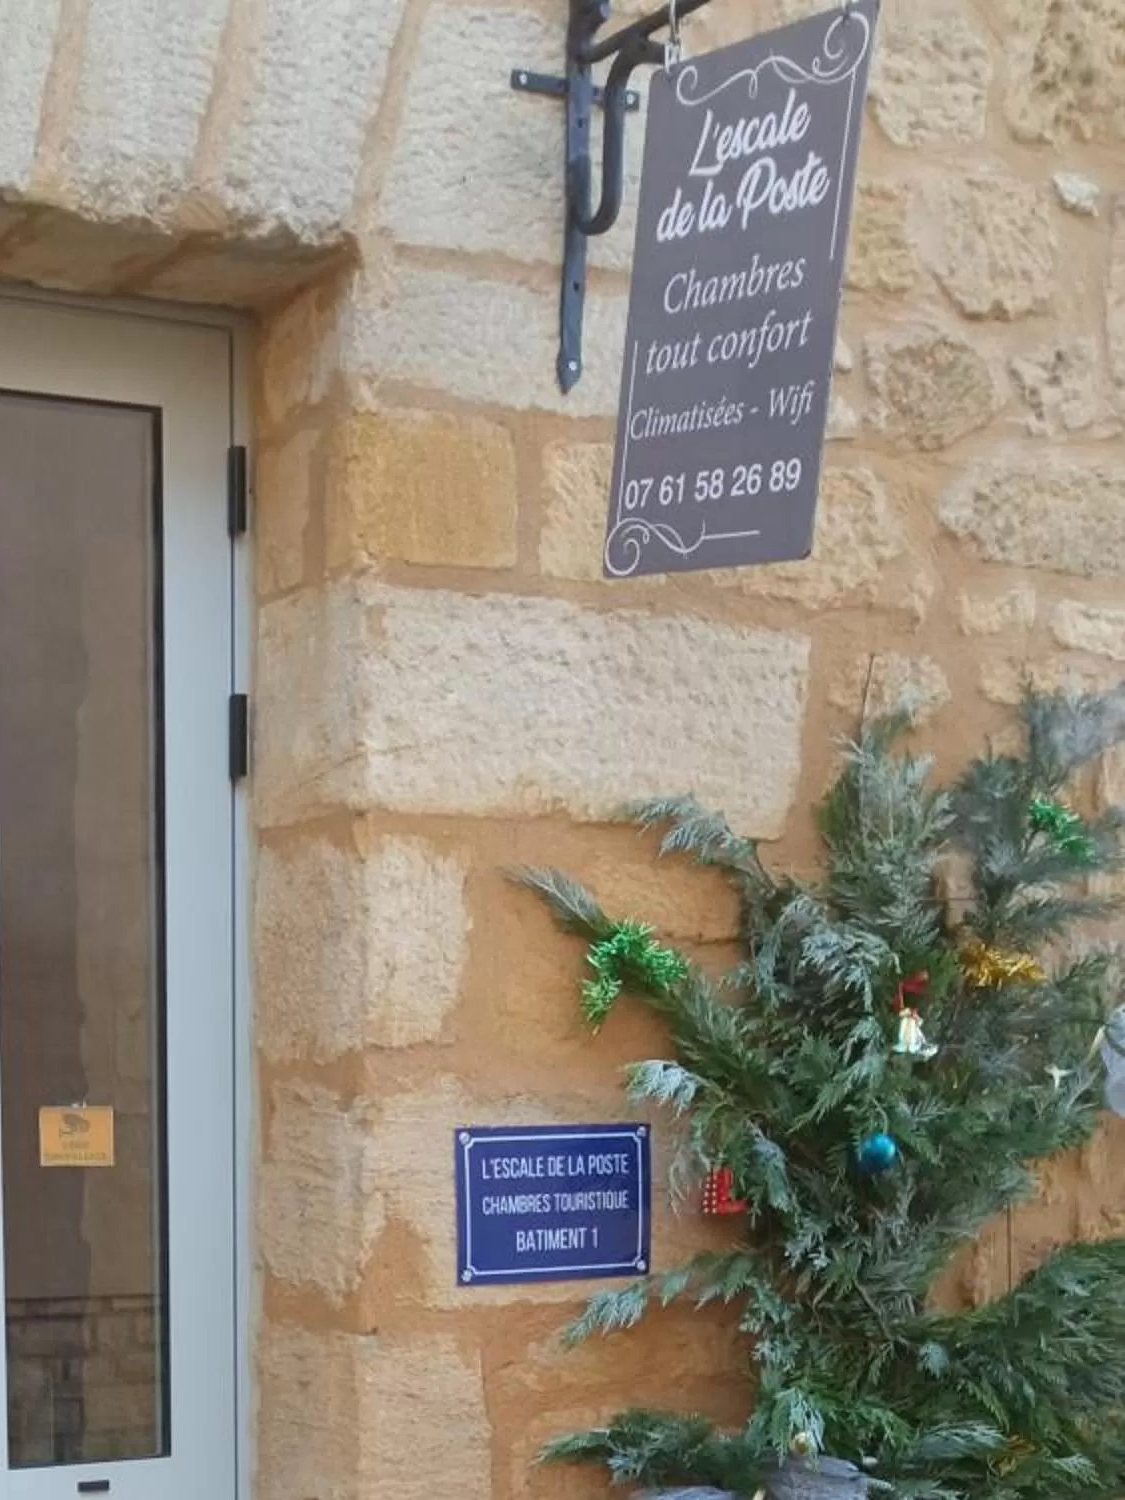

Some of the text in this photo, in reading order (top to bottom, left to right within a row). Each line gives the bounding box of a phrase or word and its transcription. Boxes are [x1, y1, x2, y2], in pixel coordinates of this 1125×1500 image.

[688, 88, 811, 177] L'escale
[656, 151, 830, 243] de la Poste
[663, 253, 806, 314] Chambres
[645, 308, 814, 374] tout confort
[630, 395, 745, 441] Climatisées
[768, 379, 816, 426] Wifi
[625, 458, 802, 510] 07 61 58 26 89
[481, 1153, 629, 1180] L'ESCALE DE LA POSTE
[481, 1190, 629, 1215] CHAMBRES TOURISTIQUE
[516, 1227, 599, 1252] BATIMENT 1
